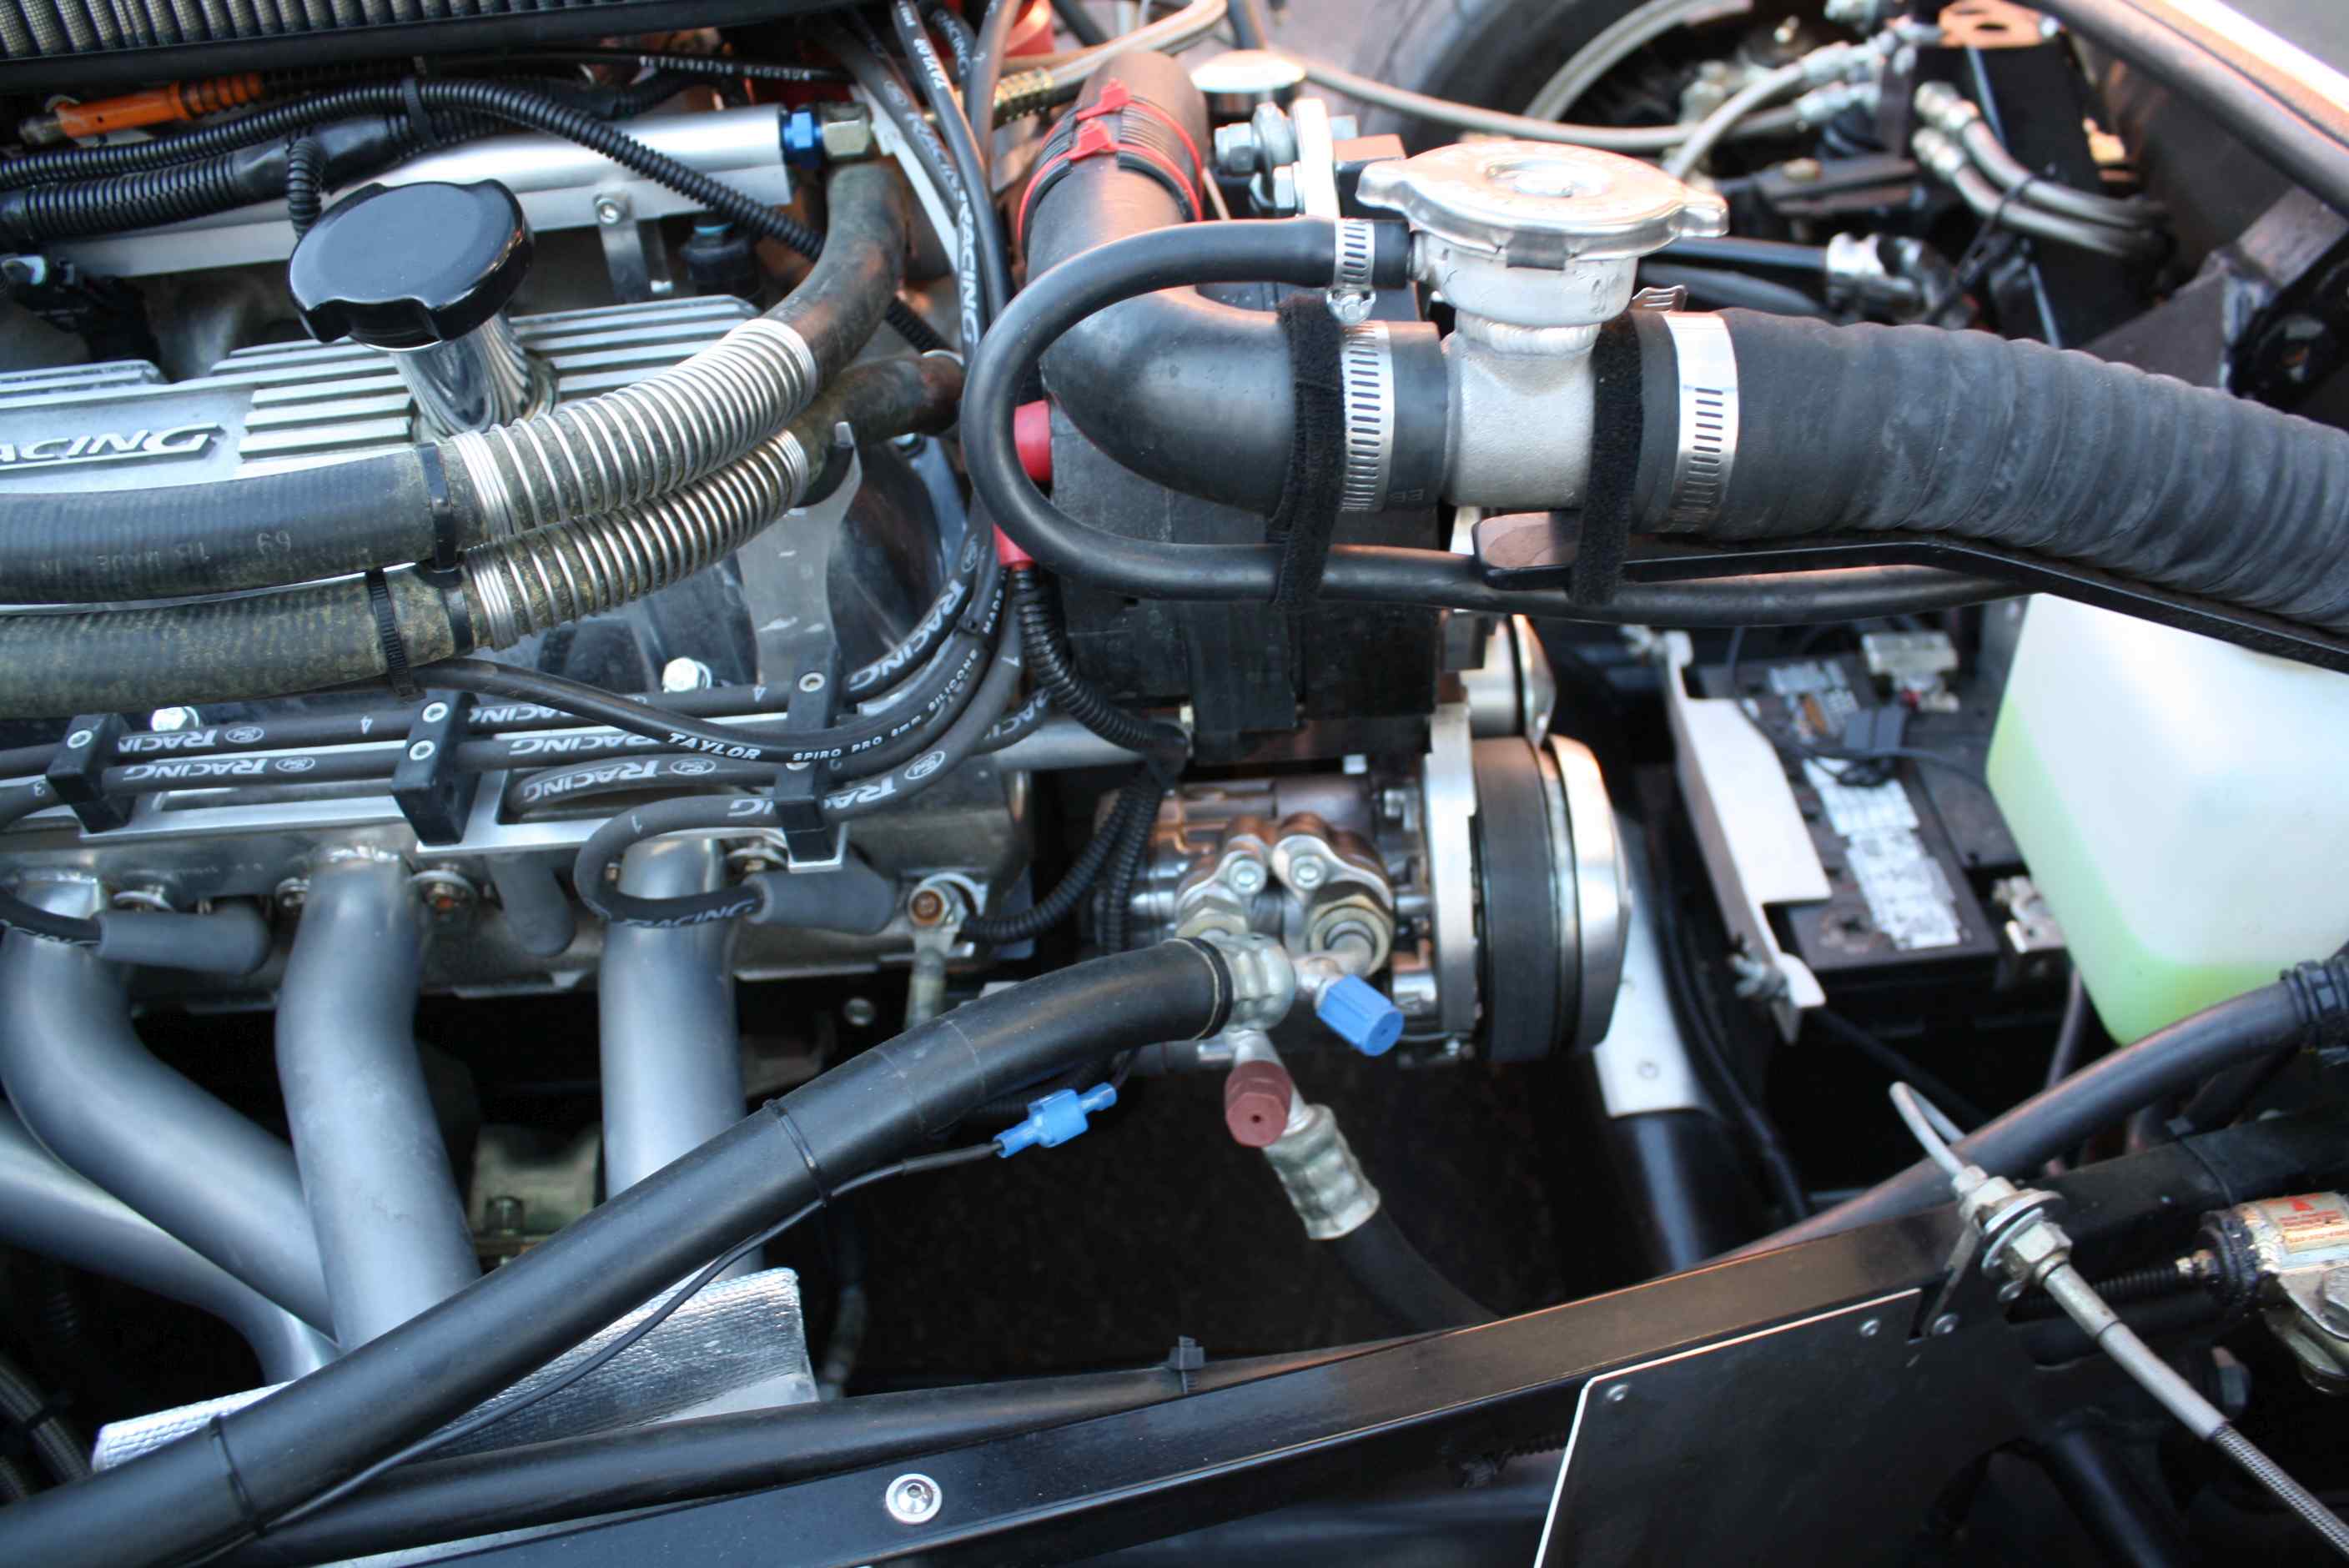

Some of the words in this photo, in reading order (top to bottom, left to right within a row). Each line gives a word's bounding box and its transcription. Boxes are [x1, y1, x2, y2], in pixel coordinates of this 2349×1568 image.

[913, 38, 949, 89] TAYLOR
[904, 111, 960, 197] RACIN
[959, 188, 979, 344] RACING
[849, 579, 967, 691] RACING
[468, 706, 576, 723] ACIN
[667, 732, 762, 760] TAYLOR
[792, 748, 843, 761] SPIRO
[852, 736, 883, 753] PRO
[928, 649, 978, 711] SILICONE
[118, 729, 218, 751] RACIN
[123, 758, 268, 781] RACING
[523, 760, 659, 802] RACING
